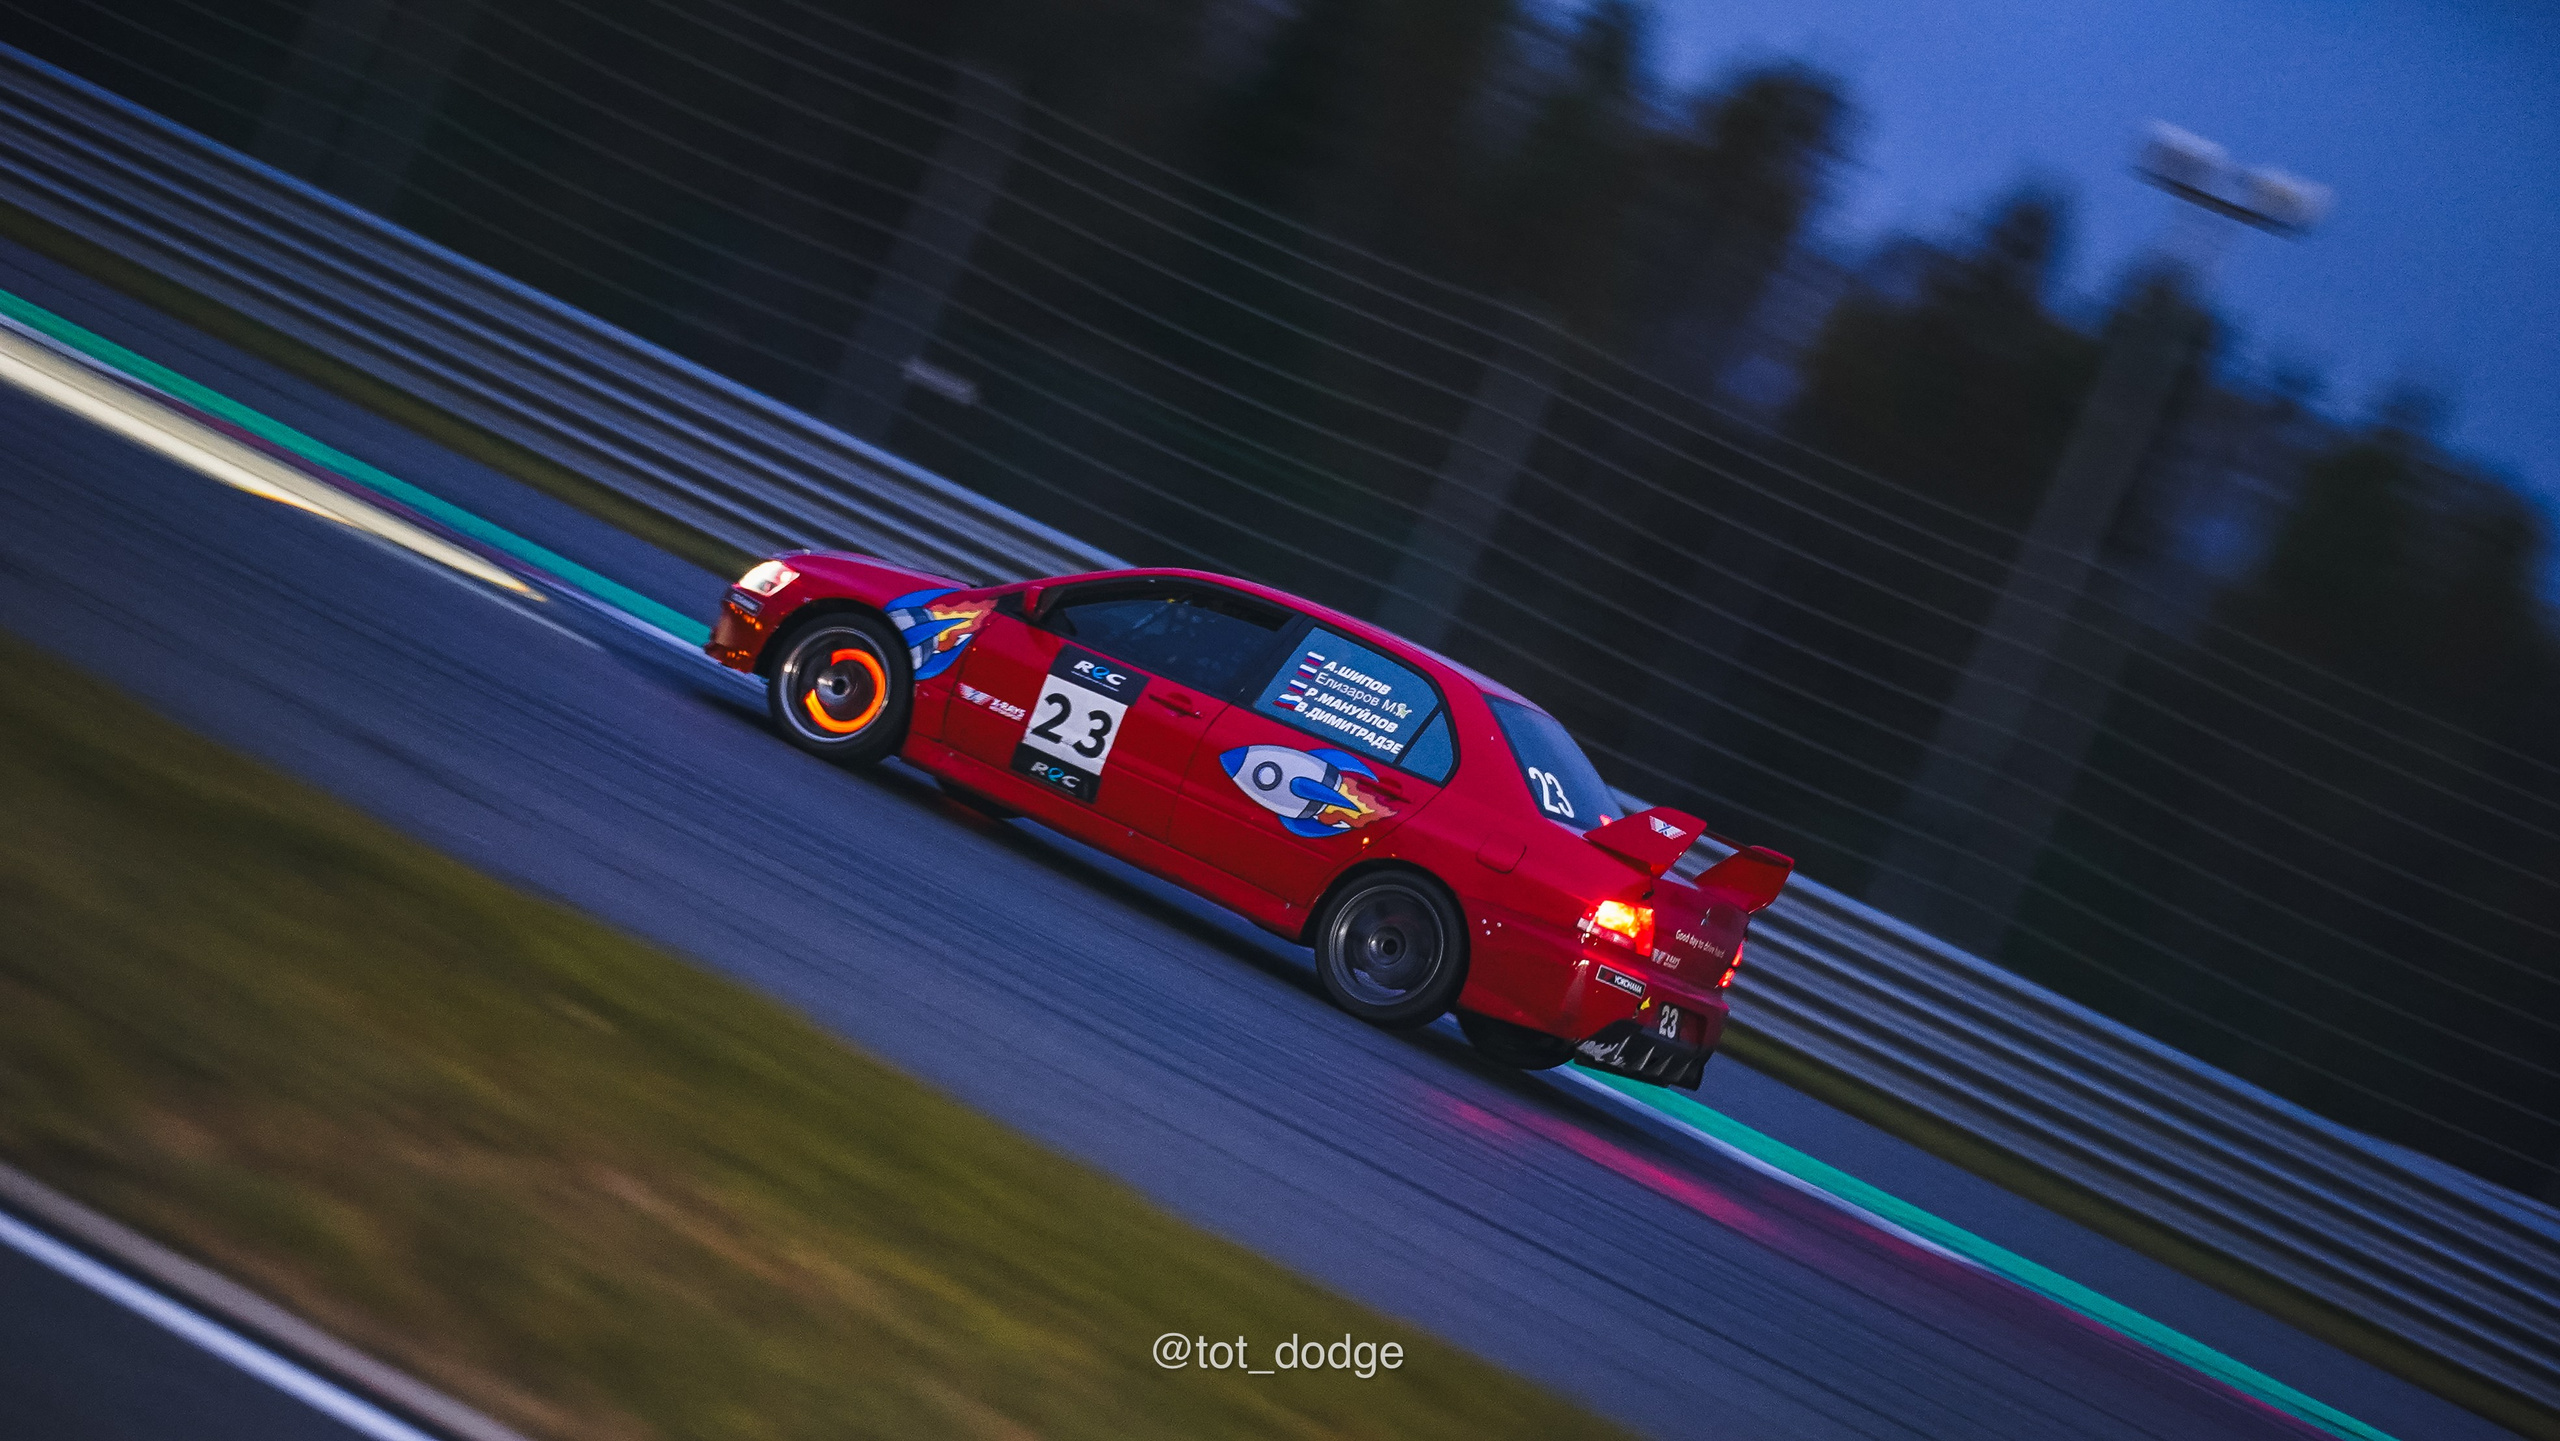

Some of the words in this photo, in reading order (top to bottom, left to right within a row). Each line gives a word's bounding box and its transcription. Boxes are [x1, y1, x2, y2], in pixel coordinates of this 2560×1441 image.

[1315, 672, 1380, 705] Елизаров
[1323, 661, 1392, 695] А.ШИПОВ
[1030, 693, 1112, 758] 23
[1294, 701, 1404, 755] В.ДИМИТРАДЗЕ
[1305, 688, 1398, 733] Р.МАНУЙЛОВ
[1528, 766, 1574, 818] 23
[1614, 975, 1642, 994] YOKOHAMA
[1659, 1004, 1679, 1039] 23
